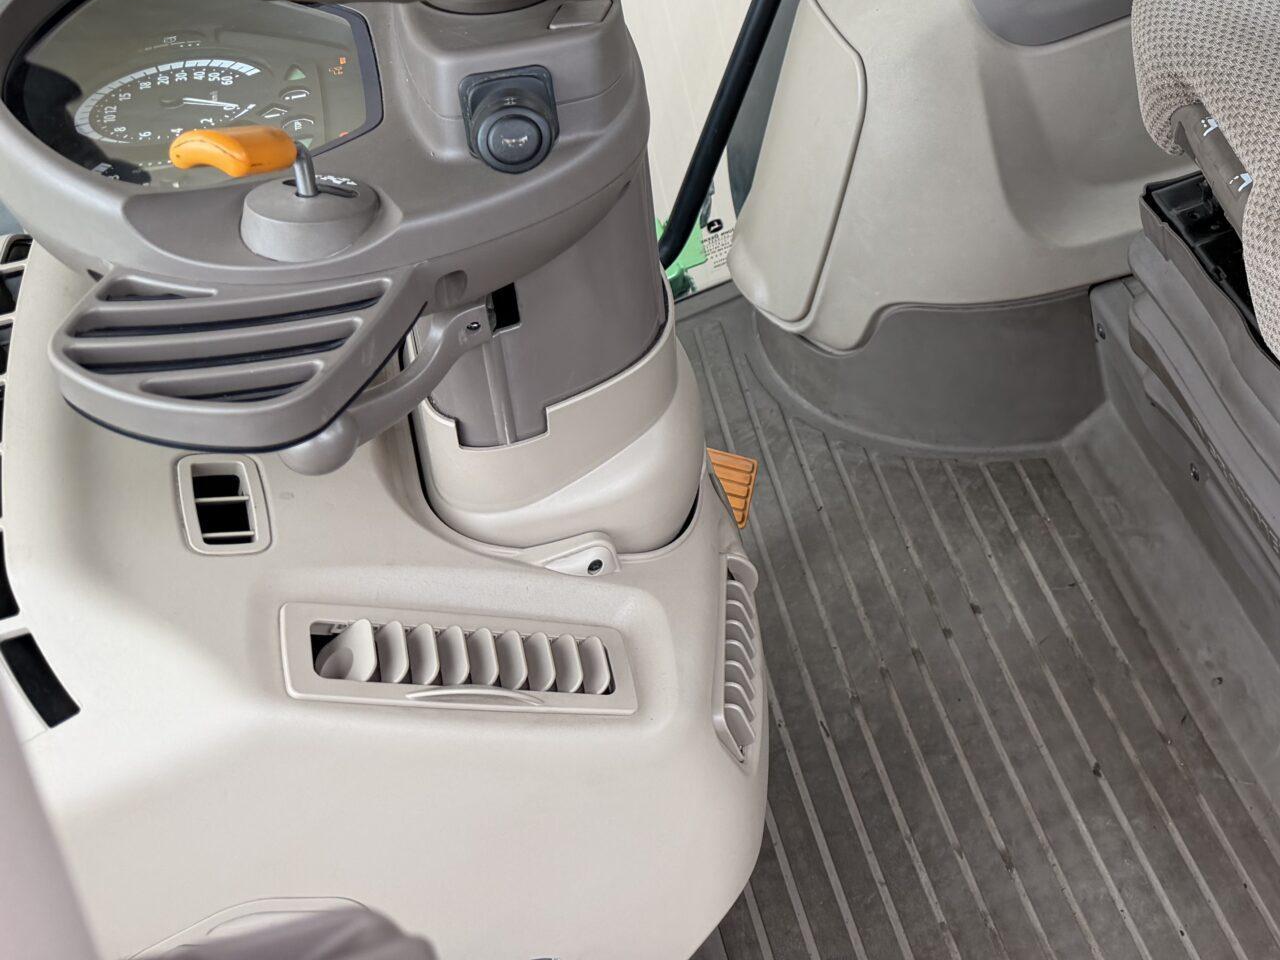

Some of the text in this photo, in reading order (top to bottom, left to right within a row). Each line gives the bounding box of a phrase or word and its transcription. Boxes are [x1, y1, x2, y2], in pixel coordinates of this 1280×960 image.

[157, 75, 170, 85] 20
[175, 72, 188, 82] 30
[194, 71, 205, 80] 40
[208, 72, 220, 82] 50
[221, 75, 233, 85] 60
[140, 81, 151, 90] 18
[119, 92, 132, 101] 15
[104, 105, 117, 114] 12
[104, 113, 116, 123] 10
